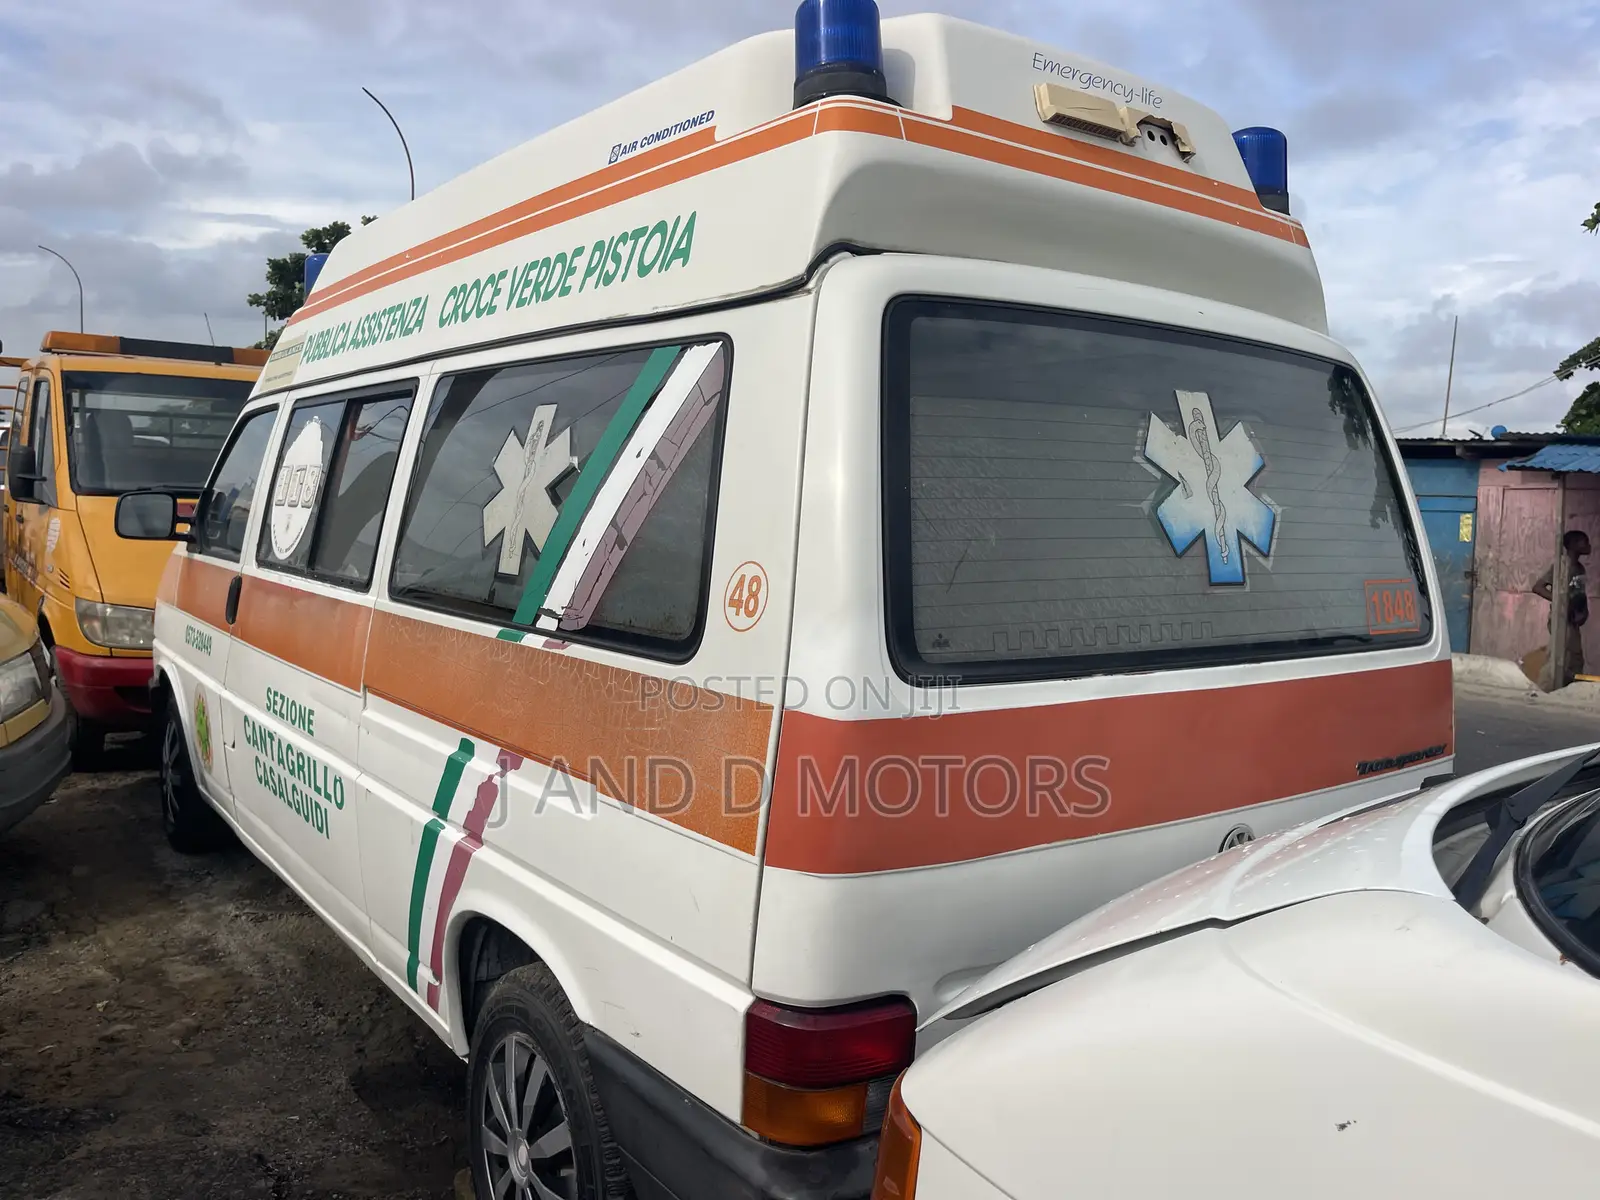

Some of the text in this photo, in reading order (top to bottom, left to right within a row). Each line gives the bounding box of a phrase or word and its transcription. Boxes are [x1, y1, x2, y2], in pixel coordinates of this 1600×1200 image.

[1032, 52, 1163, 109] Emergency-life
[620, 110, 715, 156] AIR CONDITIONED
[438, 210, 697, 328] CROCE VERDE PISTOIA
[300, 320, 352, 365] PUBBLICA
[347, 294, 428, 352] ASSISTENZA
[728, 573, 762, 618] 48
[1371, 590, 1415, 625] 1848
[265, 686, 315, 737] SEZIONE
[243, 714, 345, 811] CANTAGRILLO
[254, 755, 330, 840] CASALGUIDI
